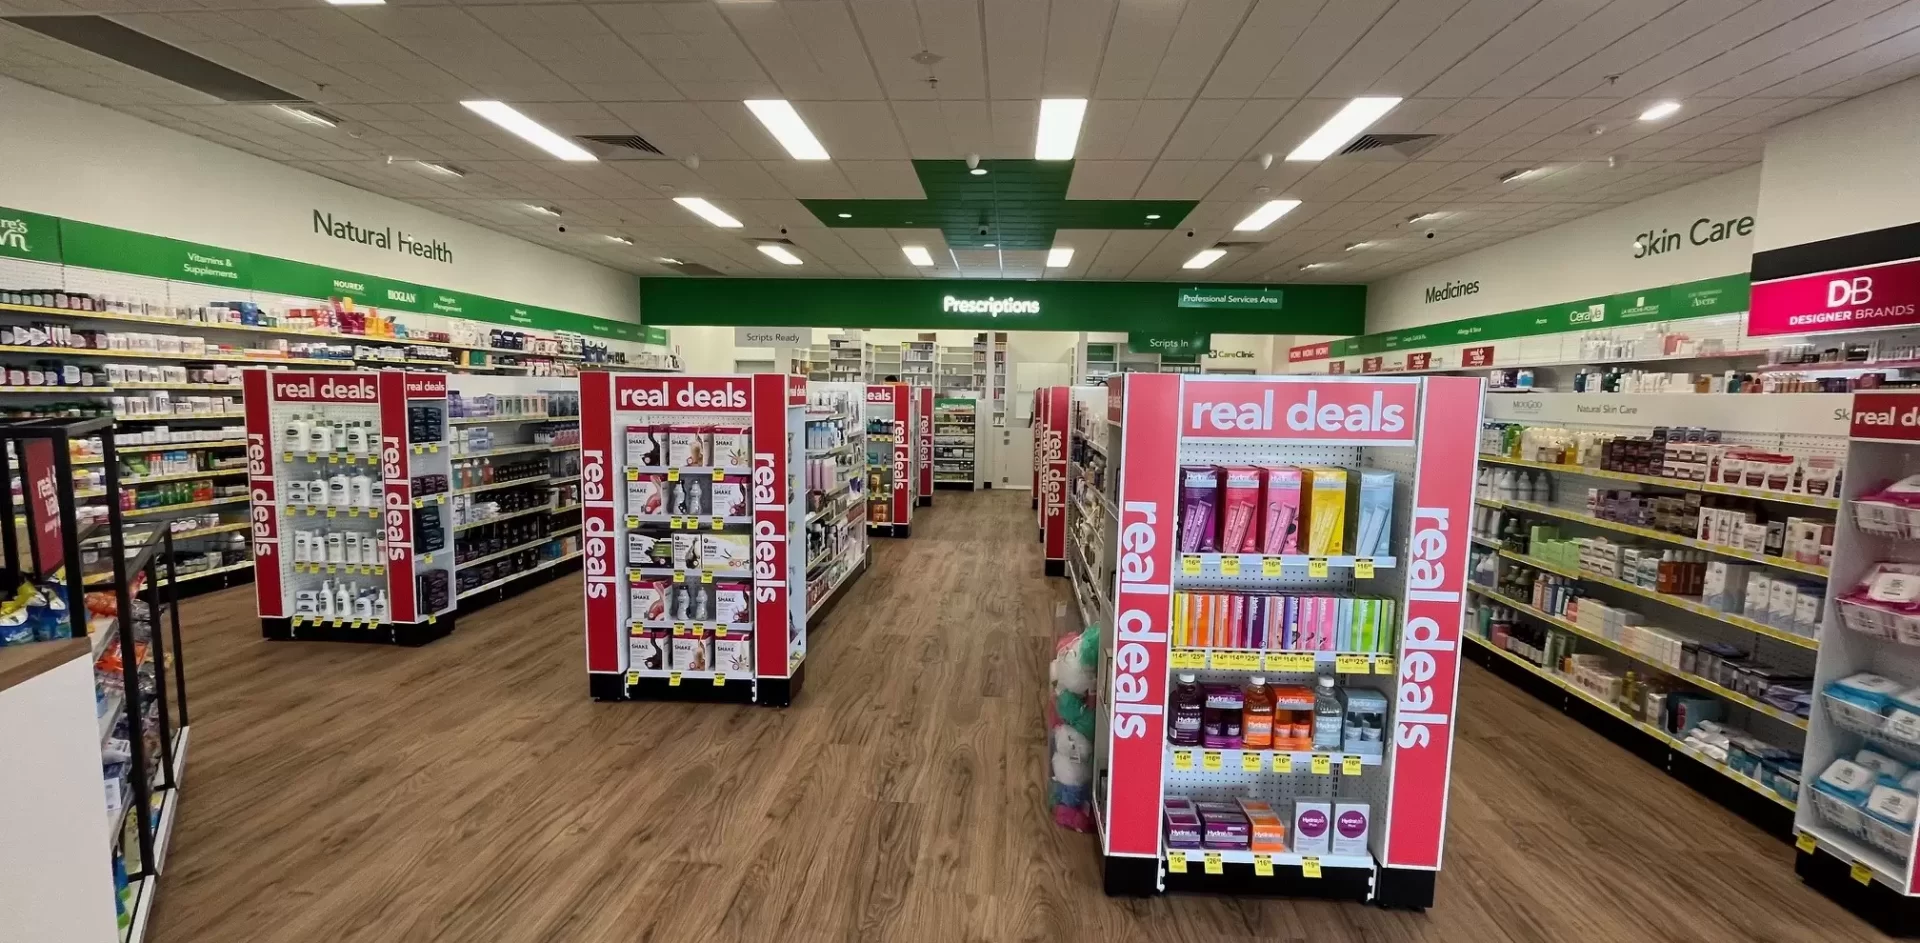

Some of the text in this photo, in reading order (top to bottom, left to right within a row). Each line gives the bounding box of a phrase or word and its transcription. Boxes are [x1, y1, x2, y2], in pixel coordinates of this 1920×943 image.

[313, 208, 453, 264] Natural Health
[1633, 216, 1755, 259] Skin Care
[183, 263, 238, 279] Supplements
[187, 252, 233, 267] Vitamins &
[387, 289, 416, 303] BIOGLAN
[1183, 294, 1226, 303] Professional
[1228, 295, 1258, 303] Services
[1425, 280, 1480, 304] Medicines
[1827, 276, 1873, 308] DB
[943, 295, 1040, 318] Prescriptions
[1569, 307, 1602, 323] CeraVe
[1789, 304, 1915, 326] DESIGNER BRANDS
[746, 332, 800, 344] Scripts Ready
[1150, 338, 1189, 349] Scripts In
[1218, 350, 1255, 358] CareClinic
[277, 377, 376, 400] real deals
[407, 381, 445, 392] real deals
[621, 381, 747, 408] real deals
[1192, 389, 1405, 432] real deals
[1577, 404, 1638, 414] Natural Skin Care
[1855, 406, 1920, 427] real d
[920, 415, 931, 469] real deals
[894, 420, 908, 490] real deals
[1048, 430, 1066, 516] real deals
[248, 434, 278, 556] real deals
[383, 437, 412, 561] real deals
[584, 450, 616, 598] real deals
[754, 453, 786, 603] real deals
[1114, 501, 1170, 739] real deals
[1397, 507, 1460, 749] real deals
